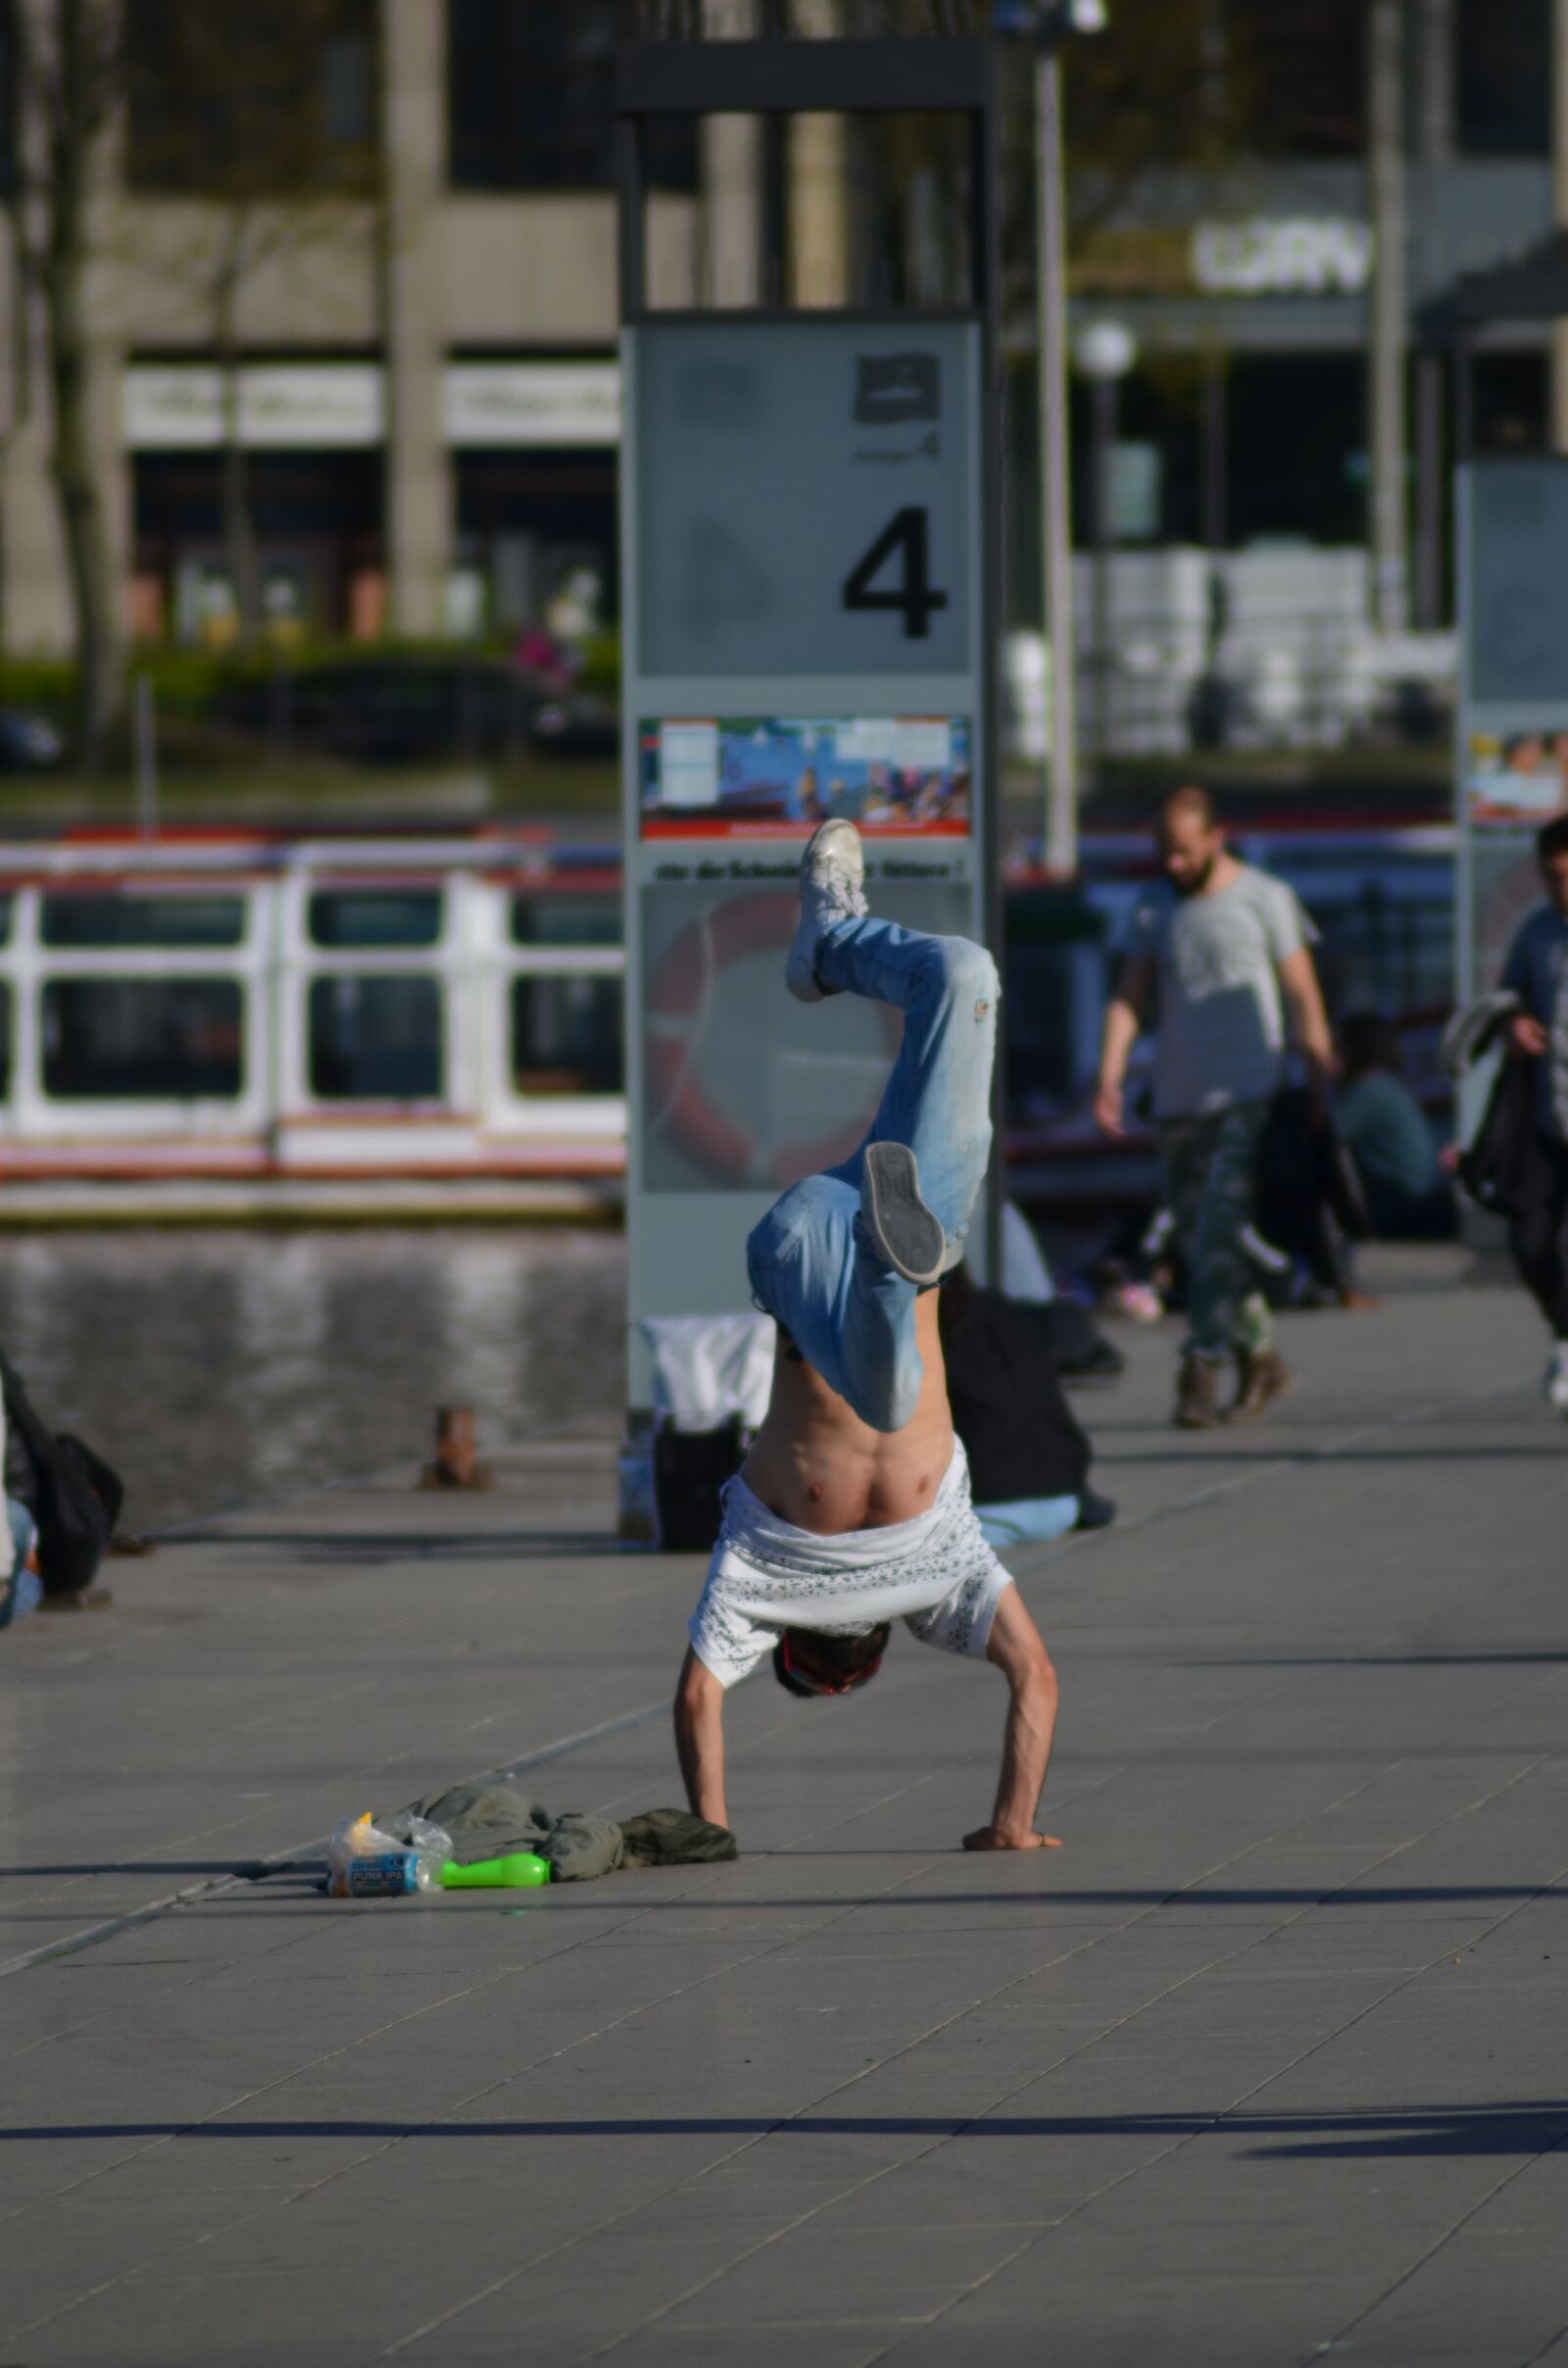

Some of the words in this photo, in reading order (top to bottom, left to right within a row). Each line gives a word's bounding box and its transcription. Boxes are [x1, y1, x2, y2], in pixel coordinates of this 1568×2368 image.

[842, 506, 948, 639] 4
[354, 1871, 384, 1881] PUNK
[386, 1870, 404, 1880] IPA
